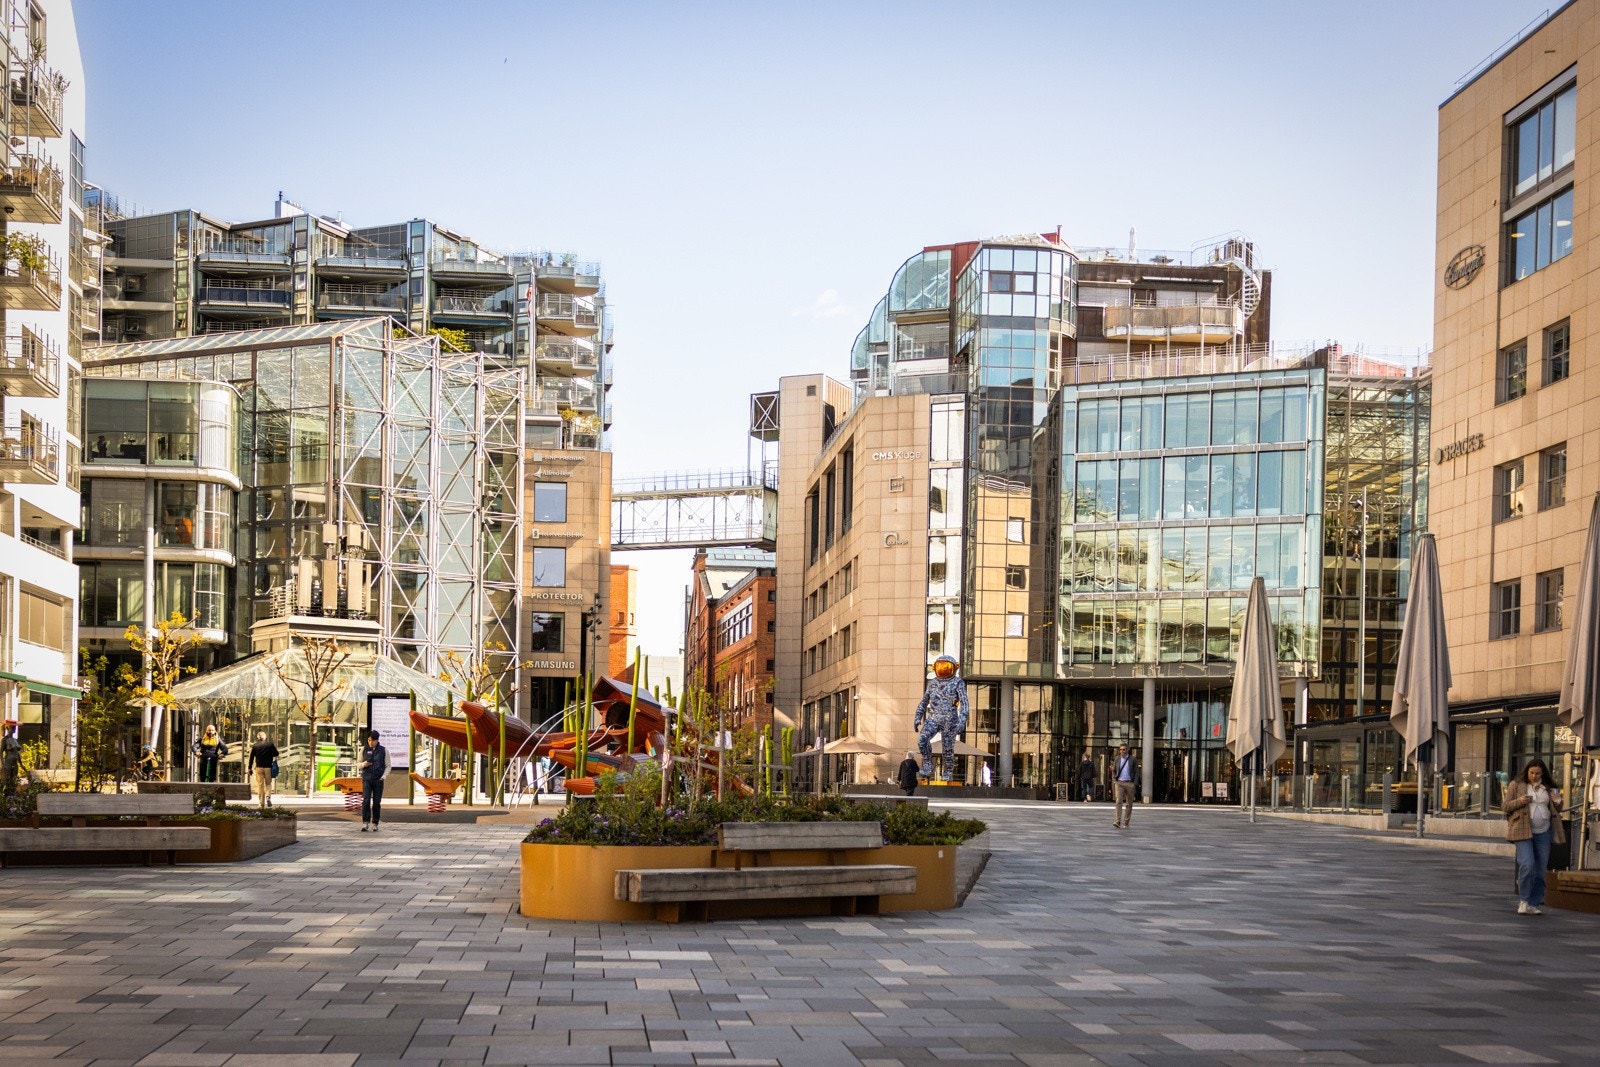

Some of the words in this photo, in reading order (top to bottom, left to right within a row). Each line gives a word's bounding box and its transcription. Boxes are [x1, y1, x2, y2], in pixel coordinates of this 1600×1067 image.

[872, 451, 893, 460] CMS
[531, 592, 583, 600] PROTECTOR
[529, 660, 575, 669] SAMSUNG
